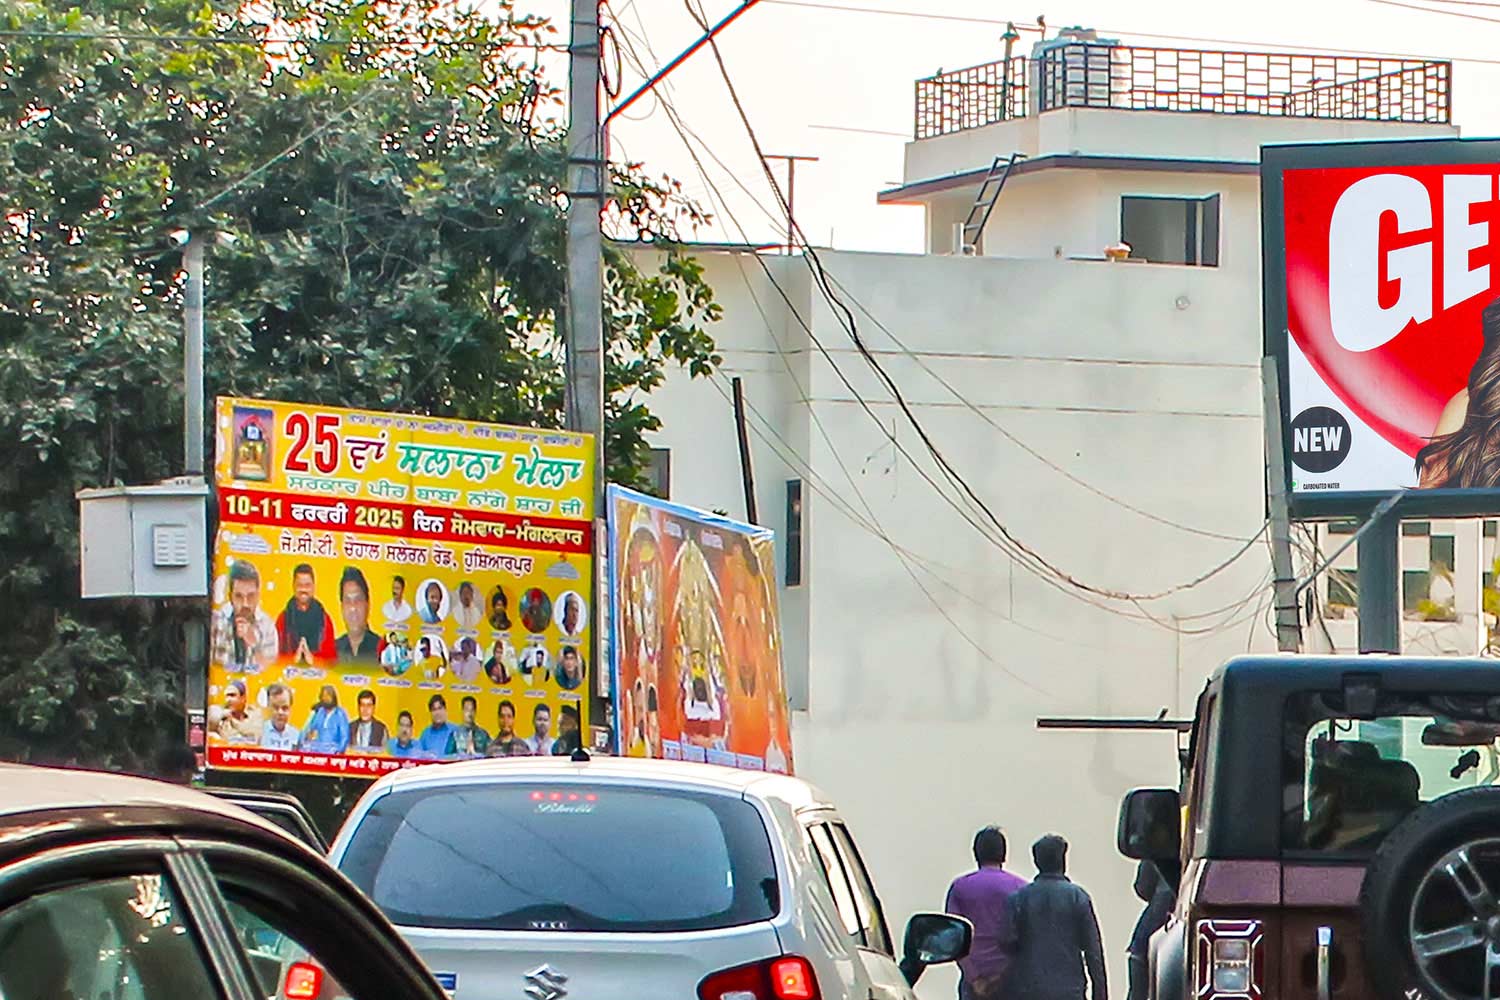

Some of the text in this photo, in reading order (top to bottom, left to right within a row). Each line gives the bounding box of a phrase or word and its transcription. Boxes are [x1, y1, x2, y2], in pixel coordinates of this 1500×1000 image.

[285, 413, 339, 474] 25
[345, 432, 385, 469] ਵਾਂ
[1294, 426, 1343, 453] NEW
[398, 444, 583, 487] ਸਲਾਨਾ ਮੇਲਾ
[226, 494, 282, 519] 10-11
[291, 503, 349, 525] ਫਰਵਰੀ
[354, 506, 404, 529] 2025
[413, 510, 445, 533] ਦਿਨ
[560, 500, 582, 515] ਜੀ
